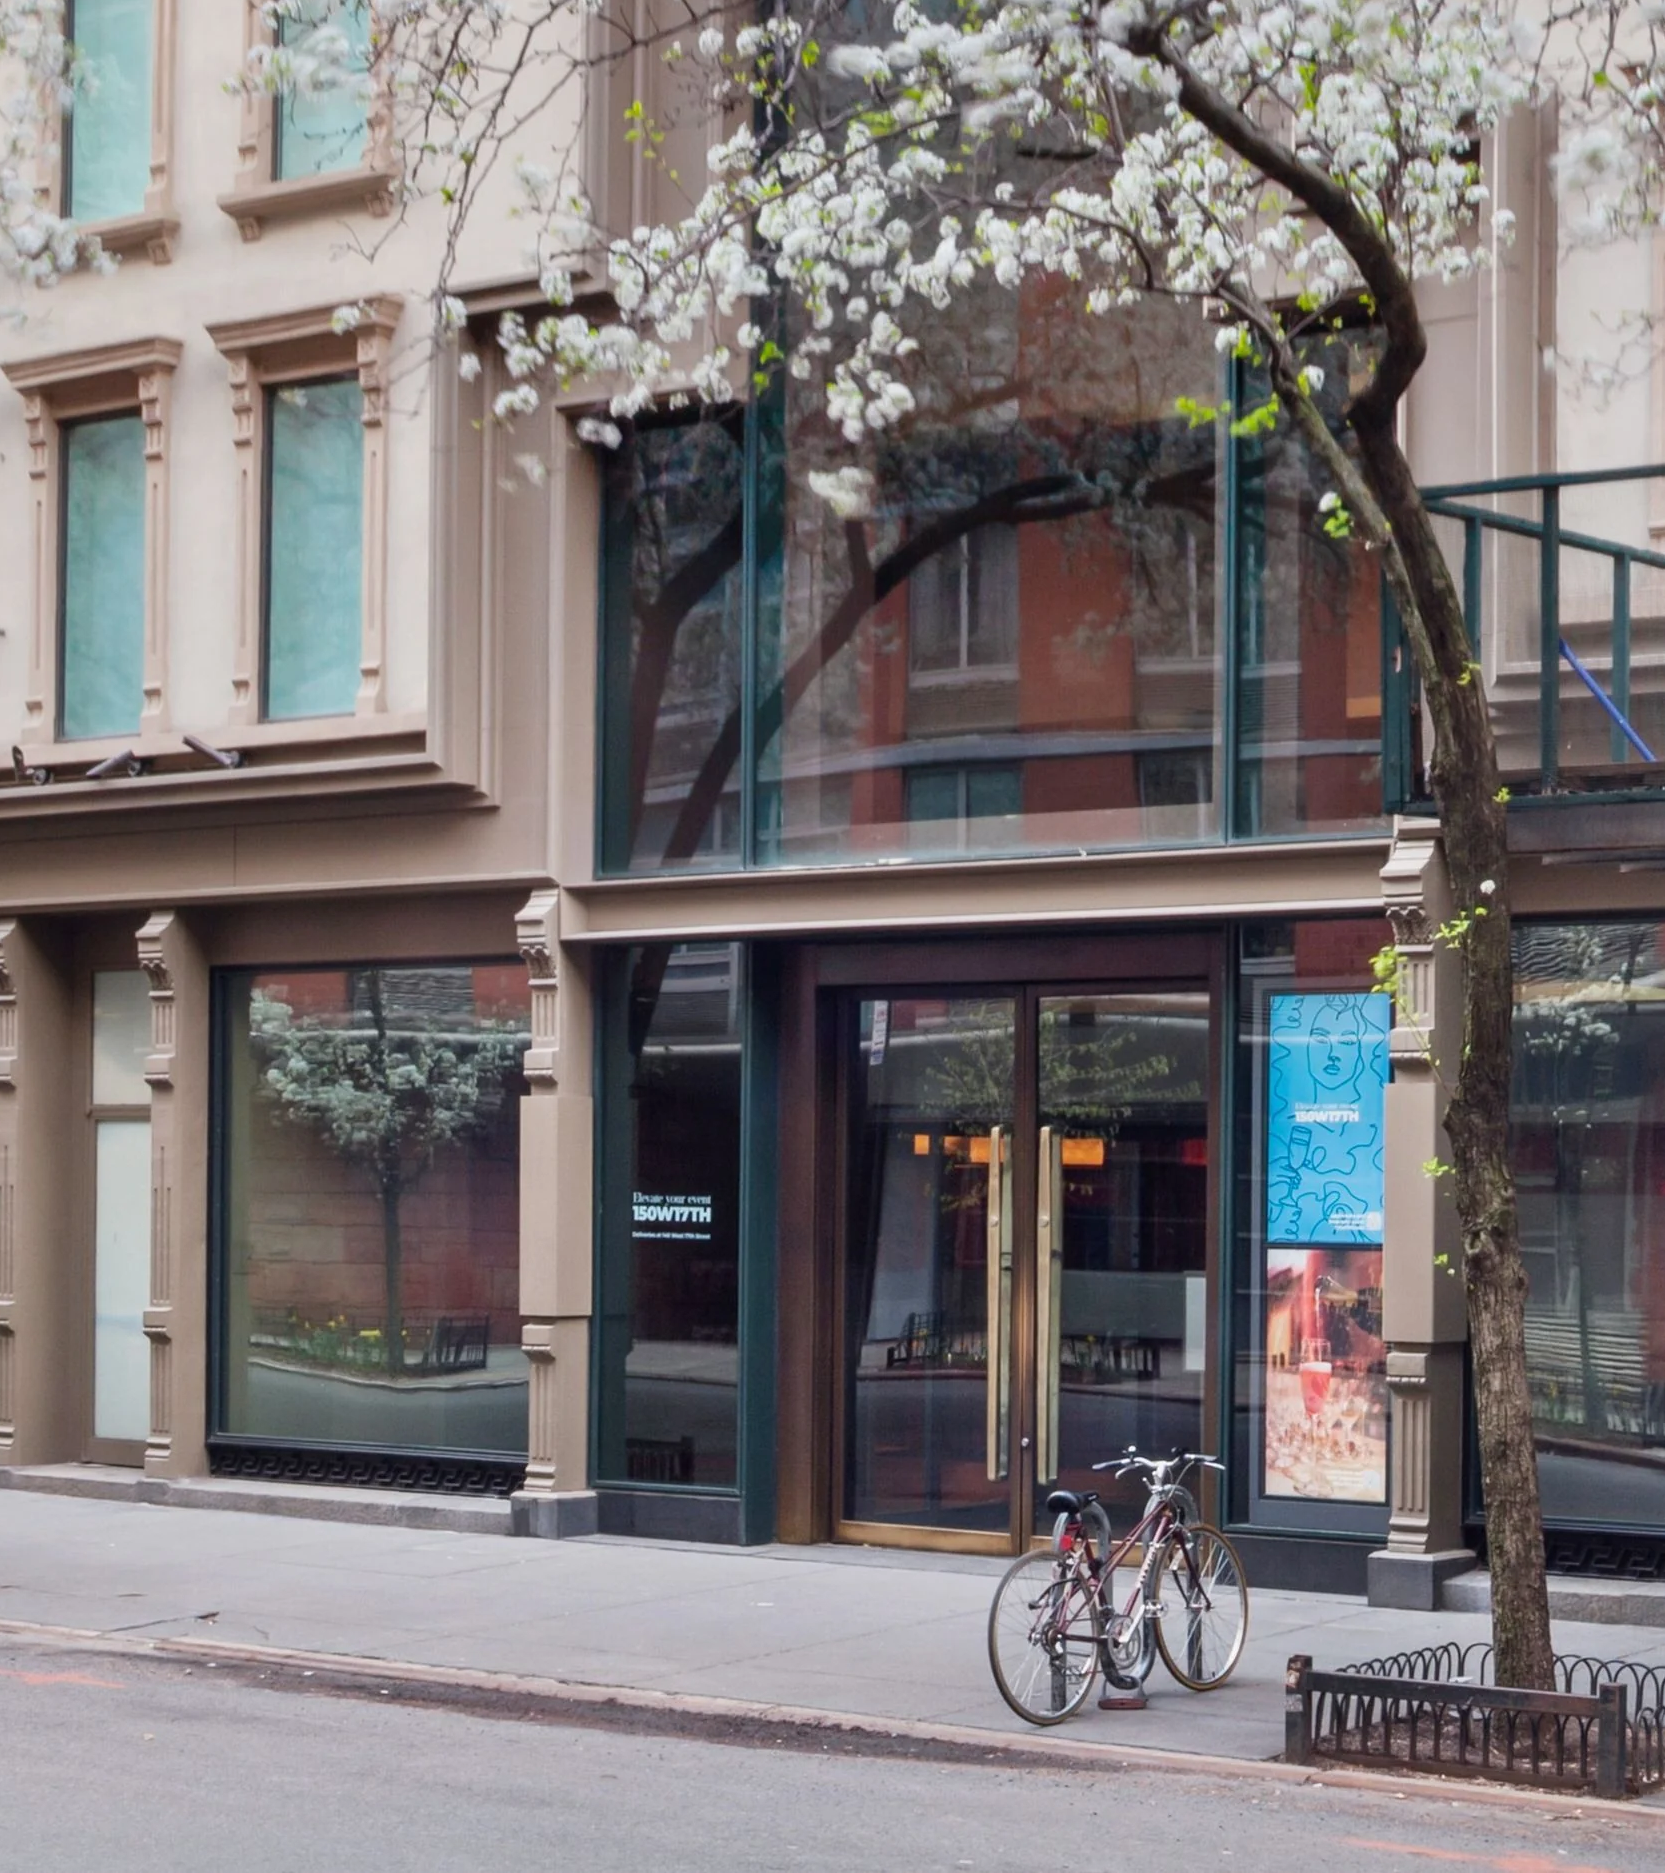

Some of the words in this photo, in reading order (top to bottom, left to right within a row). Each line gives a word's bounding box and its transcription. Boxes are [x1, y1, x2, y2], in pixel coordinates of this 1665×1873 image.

[633, 1192, 664, 1204] Elevate
[688, 1195, 711, 1205] event
[632, 1205, 711, 1223] 150W17TH
